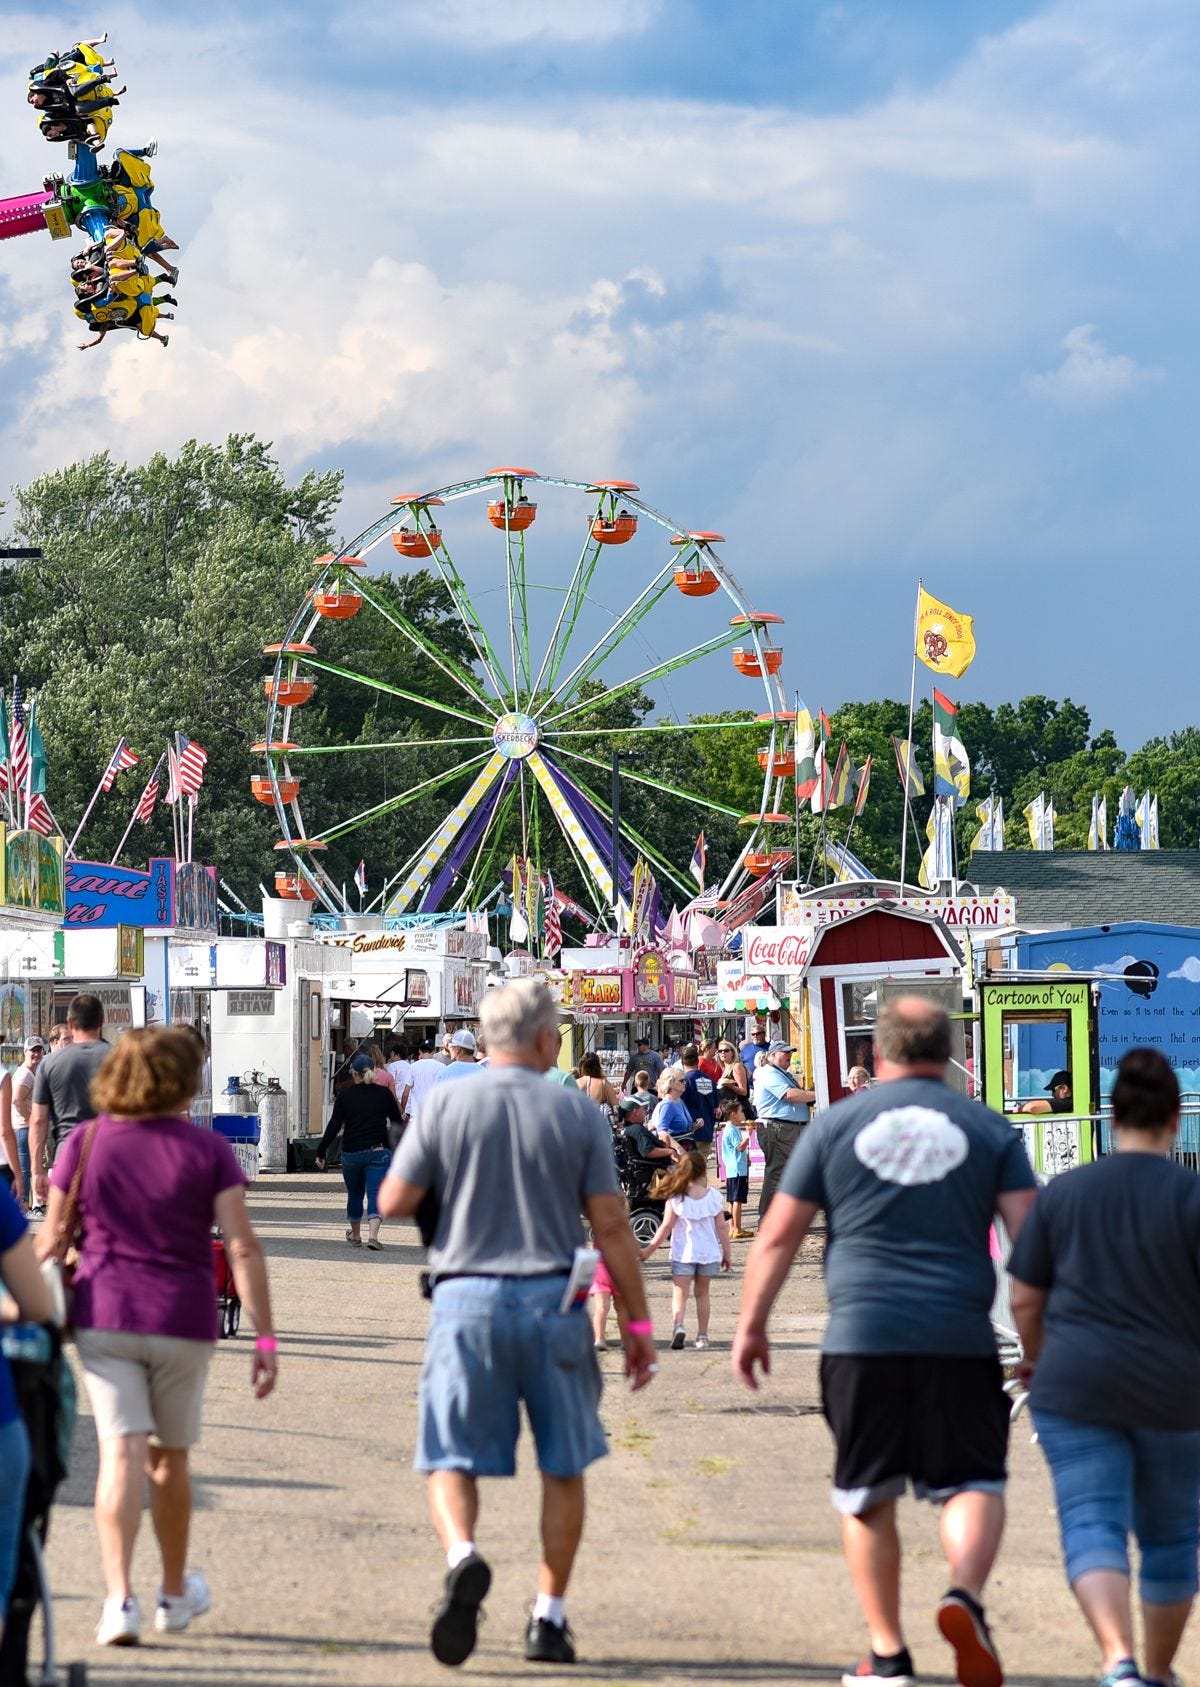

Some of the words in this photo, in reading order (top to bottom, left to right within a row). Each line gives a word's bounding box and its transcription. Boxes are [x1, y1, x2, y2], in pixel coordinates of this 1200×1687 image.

[157, 864, 168, 922] TASTY
[353, 934, 405, 954] Sandwich
[585, 978, 620, 1003] EARS
[987, 989, 1040, 1005] Cartoon
[1042, 986, 1055, 1003] of
[1058, 988, 1084, 1004] You!
[1144, 1008, 1151, 1016] is
[1153, 1008, 1166, 1016] not
[1172, 1007, 1185, 1016] the
[1111, 1034, 1118, 1043] is
[1120, 1034, 1129, 1043] in
[1133, 1032, 1162, 1043] heaven
[1170, 1032, 1185, 1043] that
